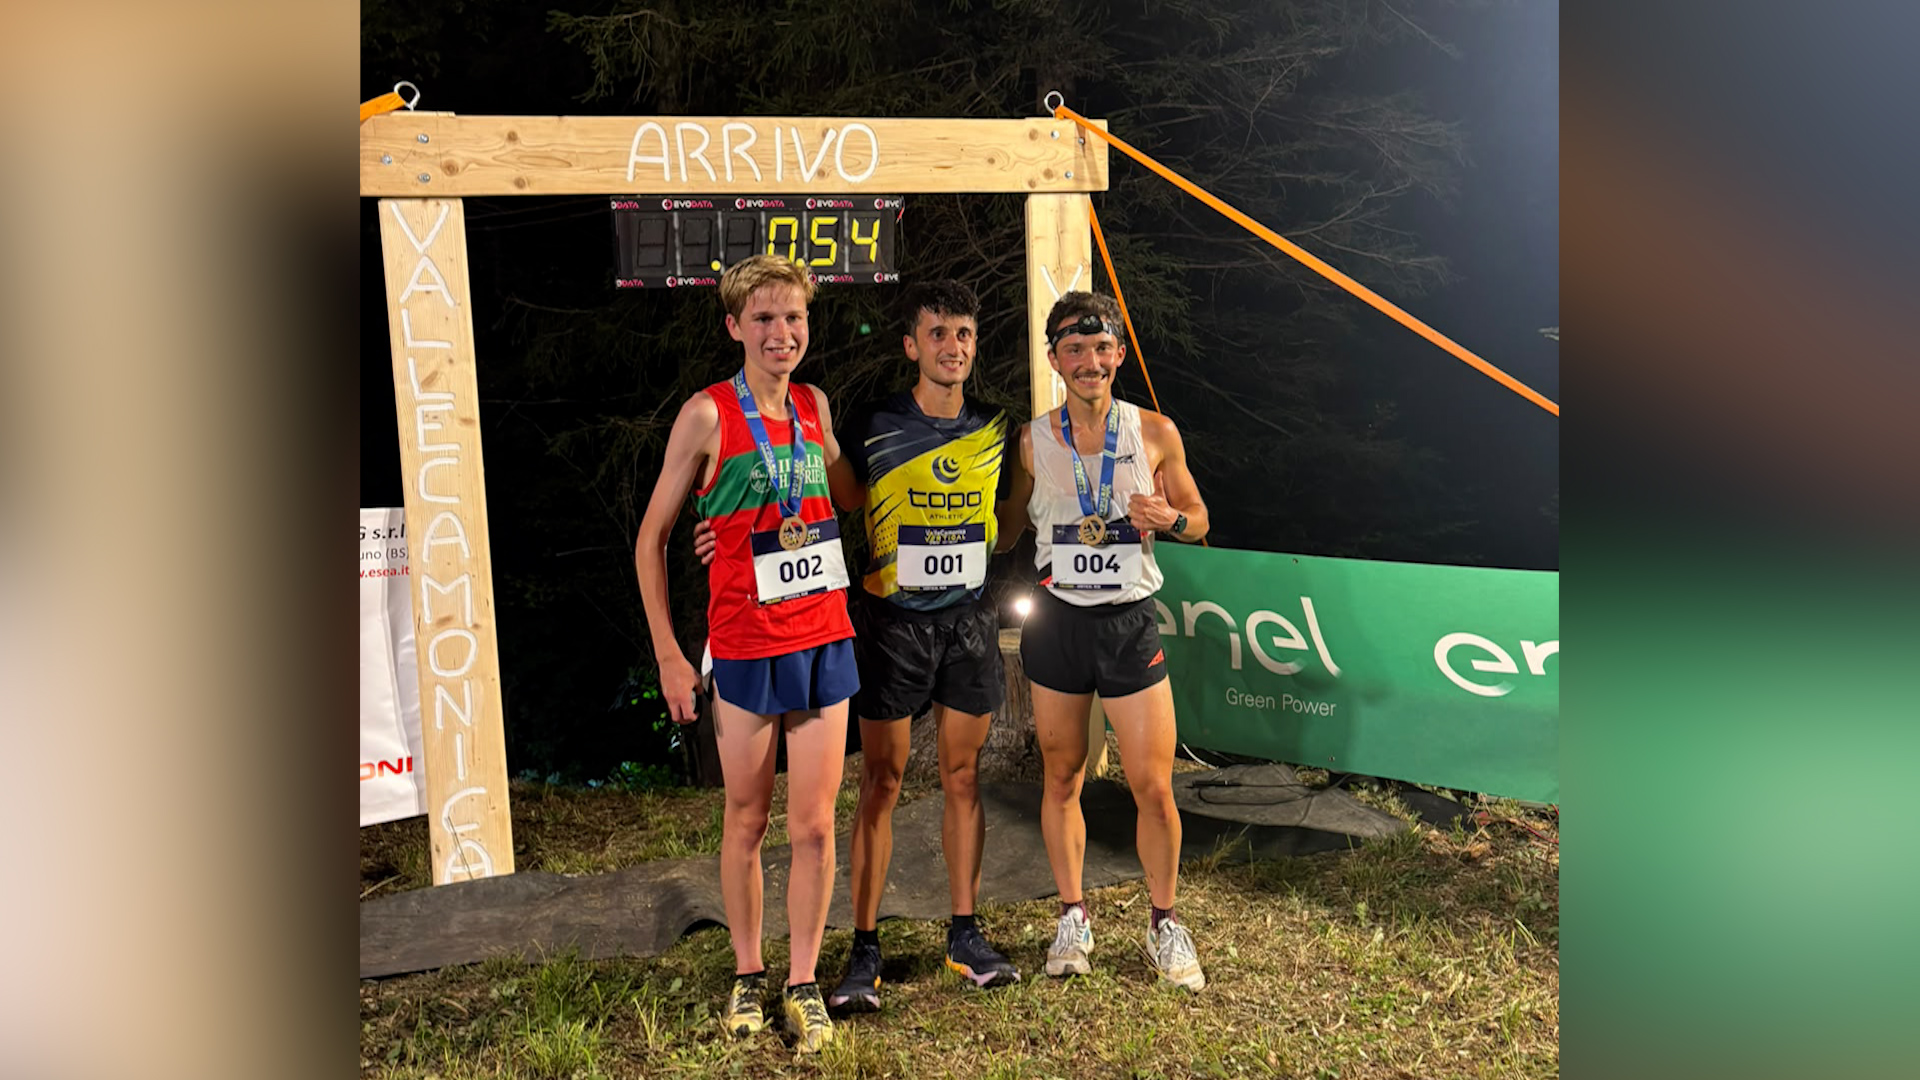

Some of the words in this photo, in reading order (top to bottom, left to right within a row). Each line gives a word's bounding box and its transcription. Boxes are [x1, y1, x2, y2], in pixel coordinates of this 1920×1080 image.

[626, 121, 879, 183] ARRIVO
[907, 487, 982, 512] topo
[390, 201, 495, 884] VALLECAMONICA
[780, 554, 824, 583] 002
[924, 553, 963, 575] 001
[1073, 553, 1121, 574] 004
[1226, 687, 1276, 710] Green
[1282, 692, 1337, 717] Power
